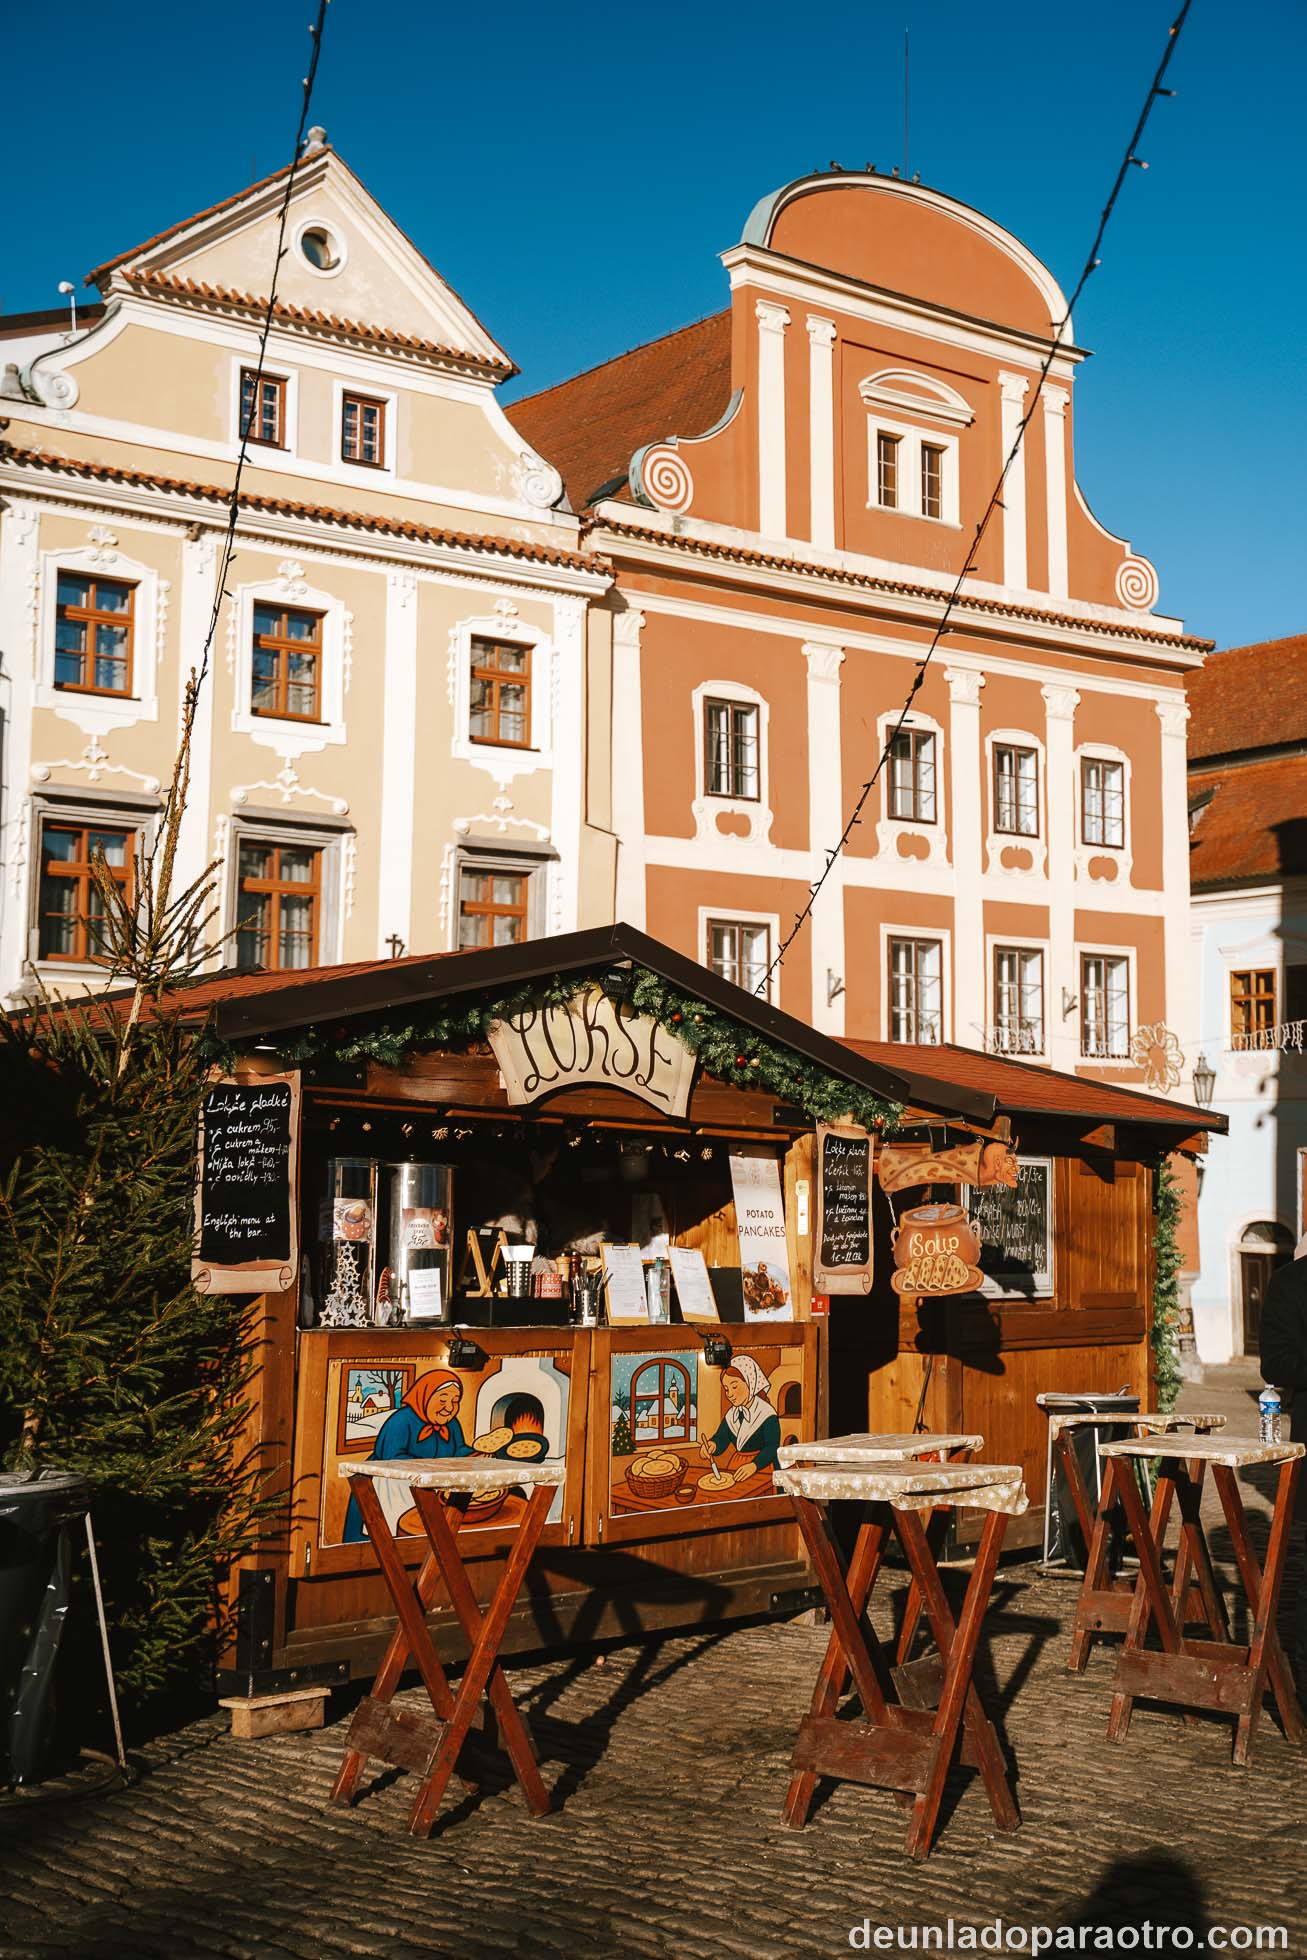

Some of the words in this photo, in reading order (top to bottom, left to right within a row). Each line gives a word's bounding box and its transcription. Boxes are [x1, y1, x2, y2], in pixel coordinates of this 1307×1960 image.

[227, 1121, 260, 1134] cukrem
[225, 1138, 253, 1149] cukrem
[746, 1209, 774, 1219] POTATO
[204, 1213, 237, 1233] English
[241, 1217, 260, 1225] menu
[265, 1212, 276, 1224] at
[738, 1225, 786, 1238] PANCAKES
[912, 1232, 960, 1257] Soup
